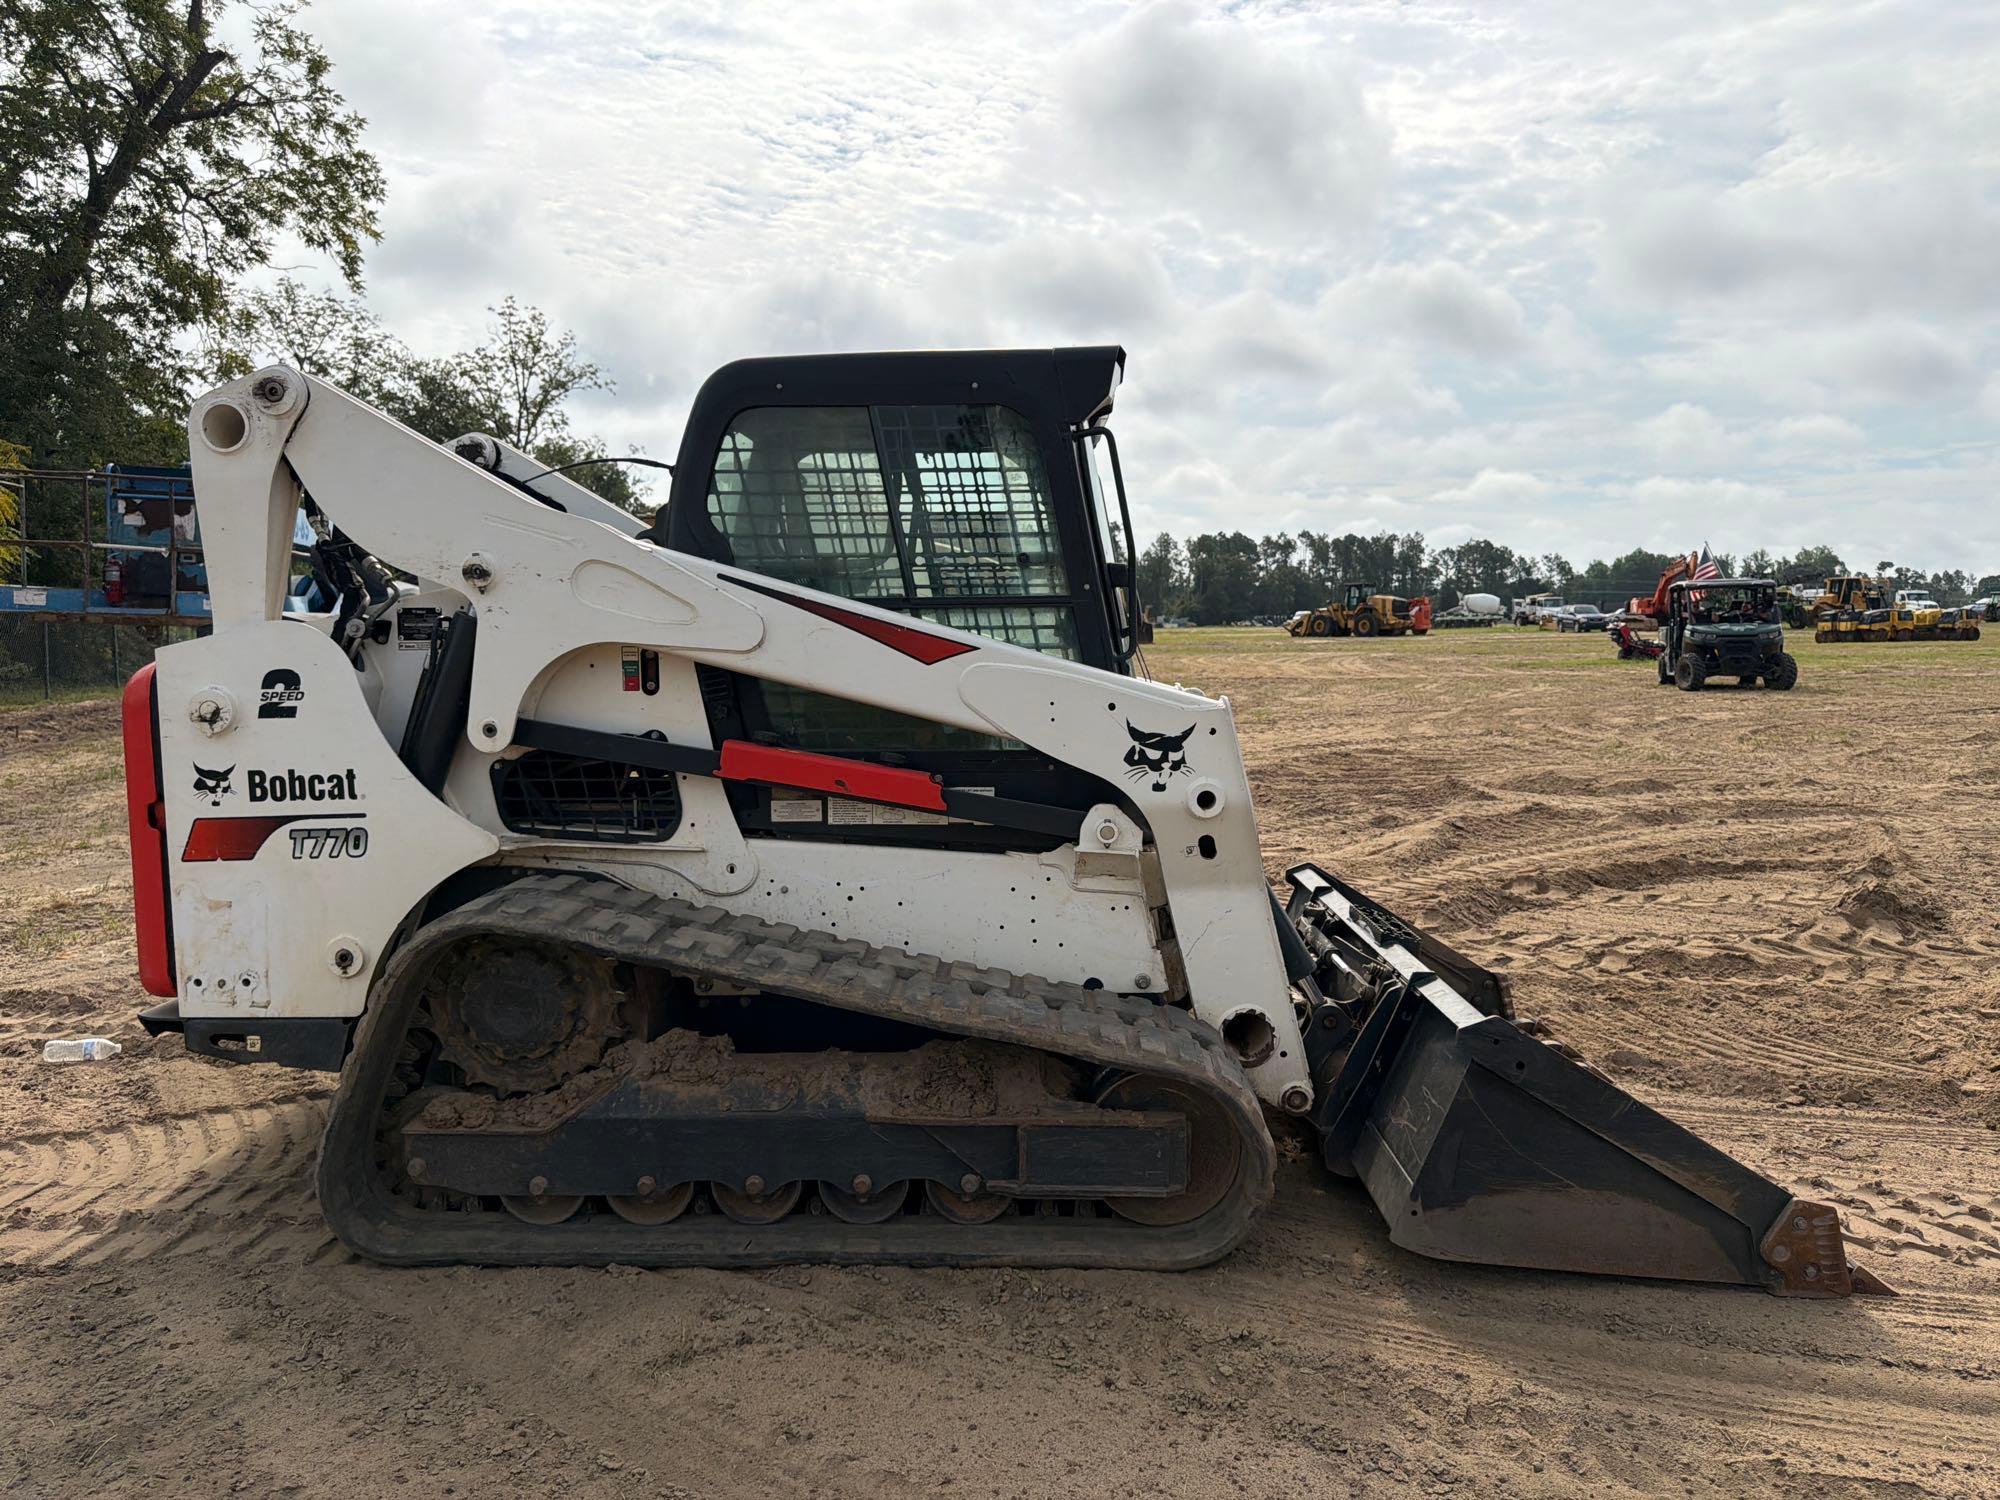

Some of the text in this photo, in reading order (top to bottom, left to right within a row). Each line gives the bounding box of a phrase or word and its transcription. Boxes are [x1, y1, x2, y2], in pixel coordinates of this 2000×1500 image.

[258, 668, 301, 719] 2
[260, 691, 305, 702] SPEED
[247, 768, 358, 803] Bobcat
[289, 827, 369, 860] T770
